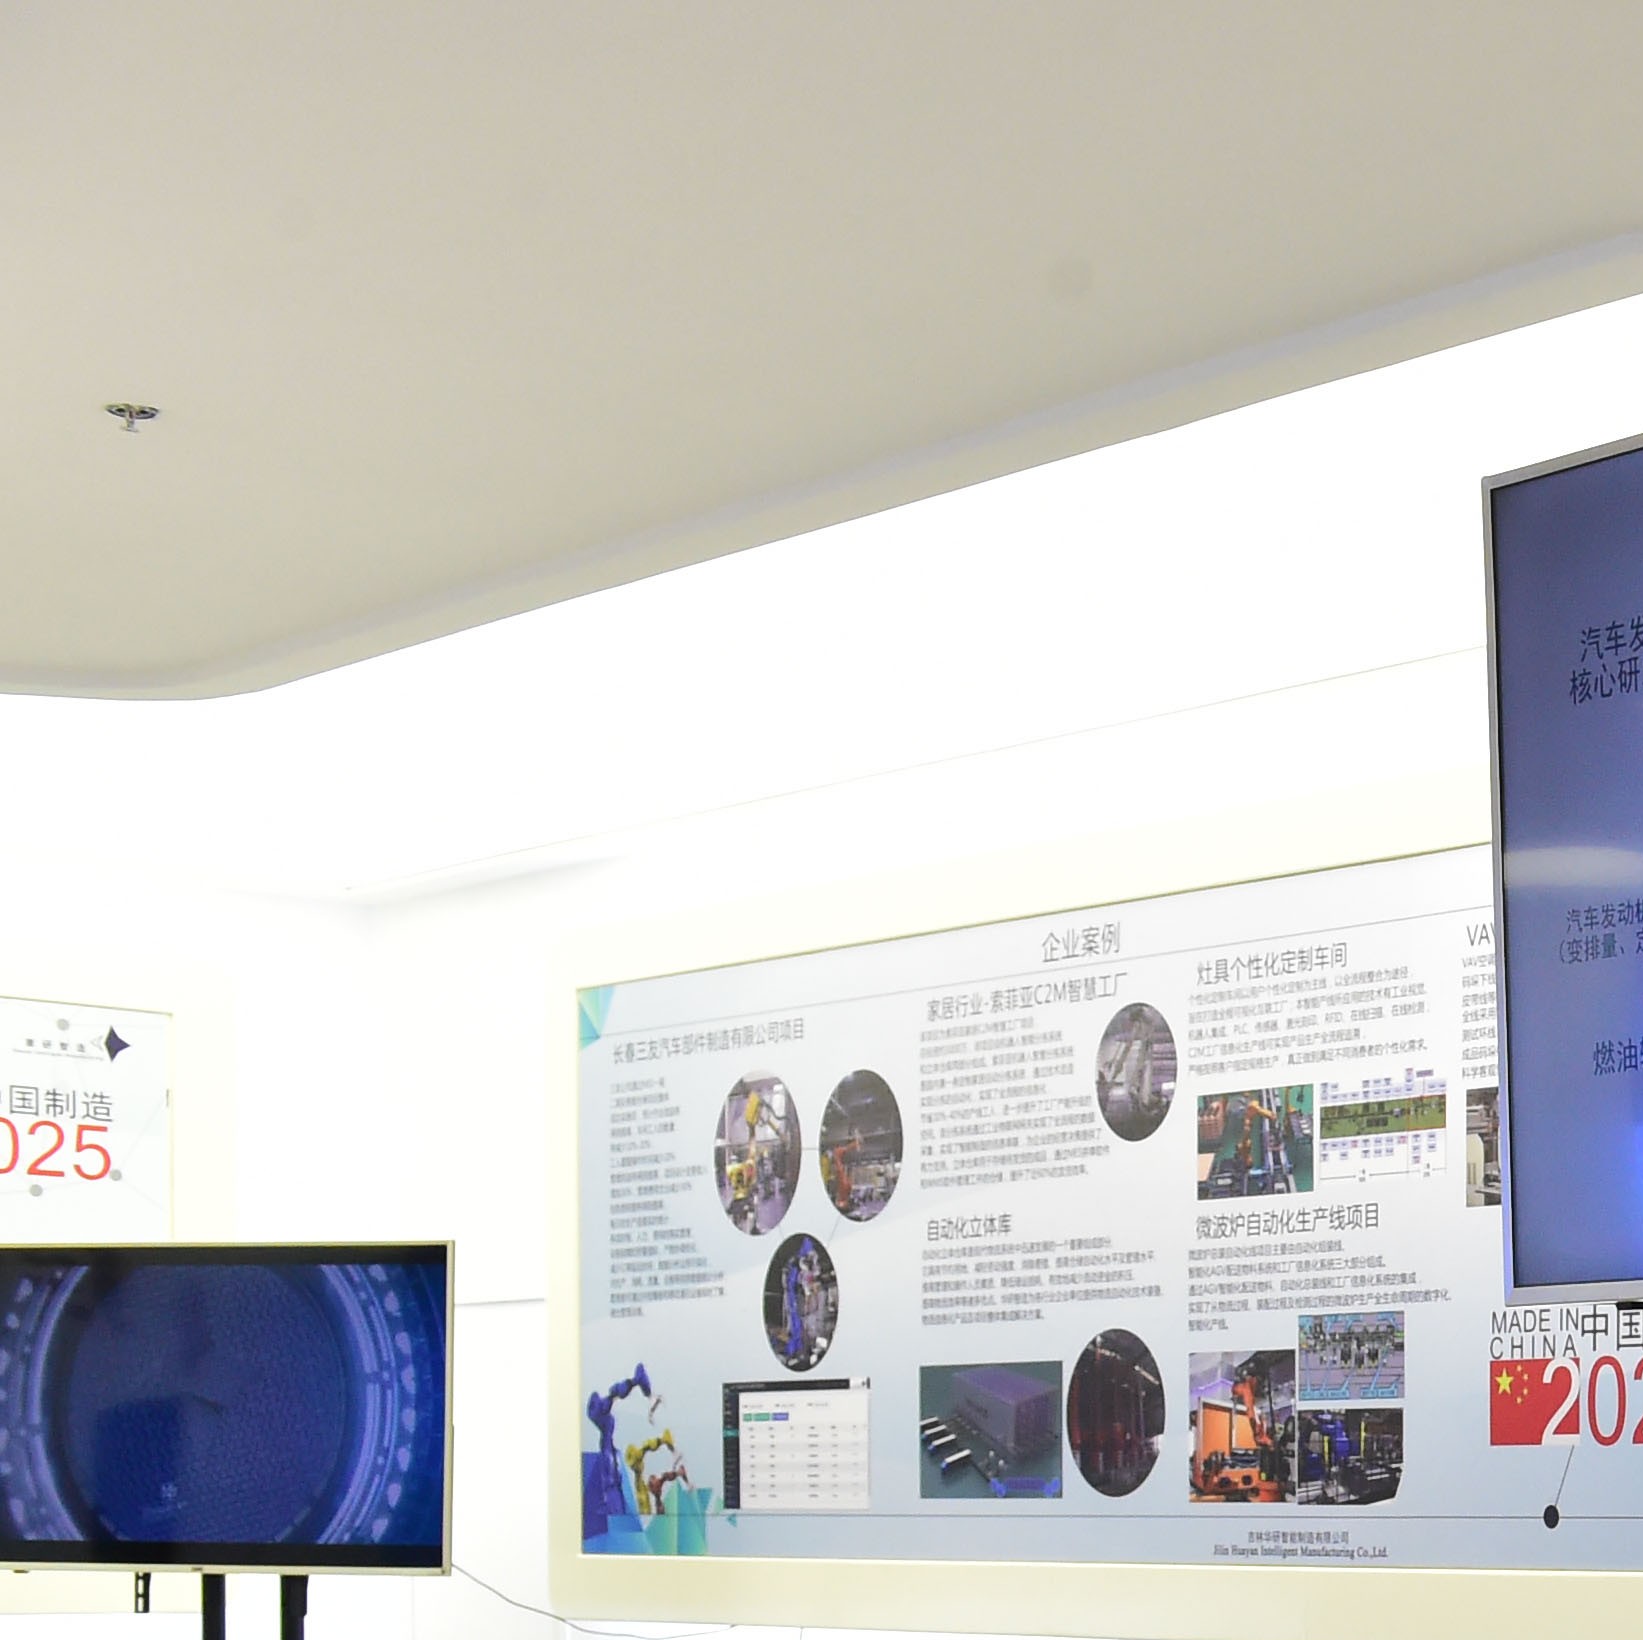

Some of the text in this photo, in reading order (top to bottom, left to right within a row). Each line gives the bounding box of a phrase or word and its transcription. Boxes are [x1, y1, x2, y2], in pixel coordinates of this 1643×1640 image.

[1041, 921, 1121, 963] 企业案例
[1197, 942, 1348, 986] 灶具个性化定制车间
[0, 1085, 113, 1122] 国制造
[927, 1213, 1012, 1241] 自动化立体库
[1196, 1202, 1380, 1240] 微波炉自动化生产线项目
[1491, 1306, 1579, 1335] MADE IN
[1489, 1334, 1578, 1361] CHINA
